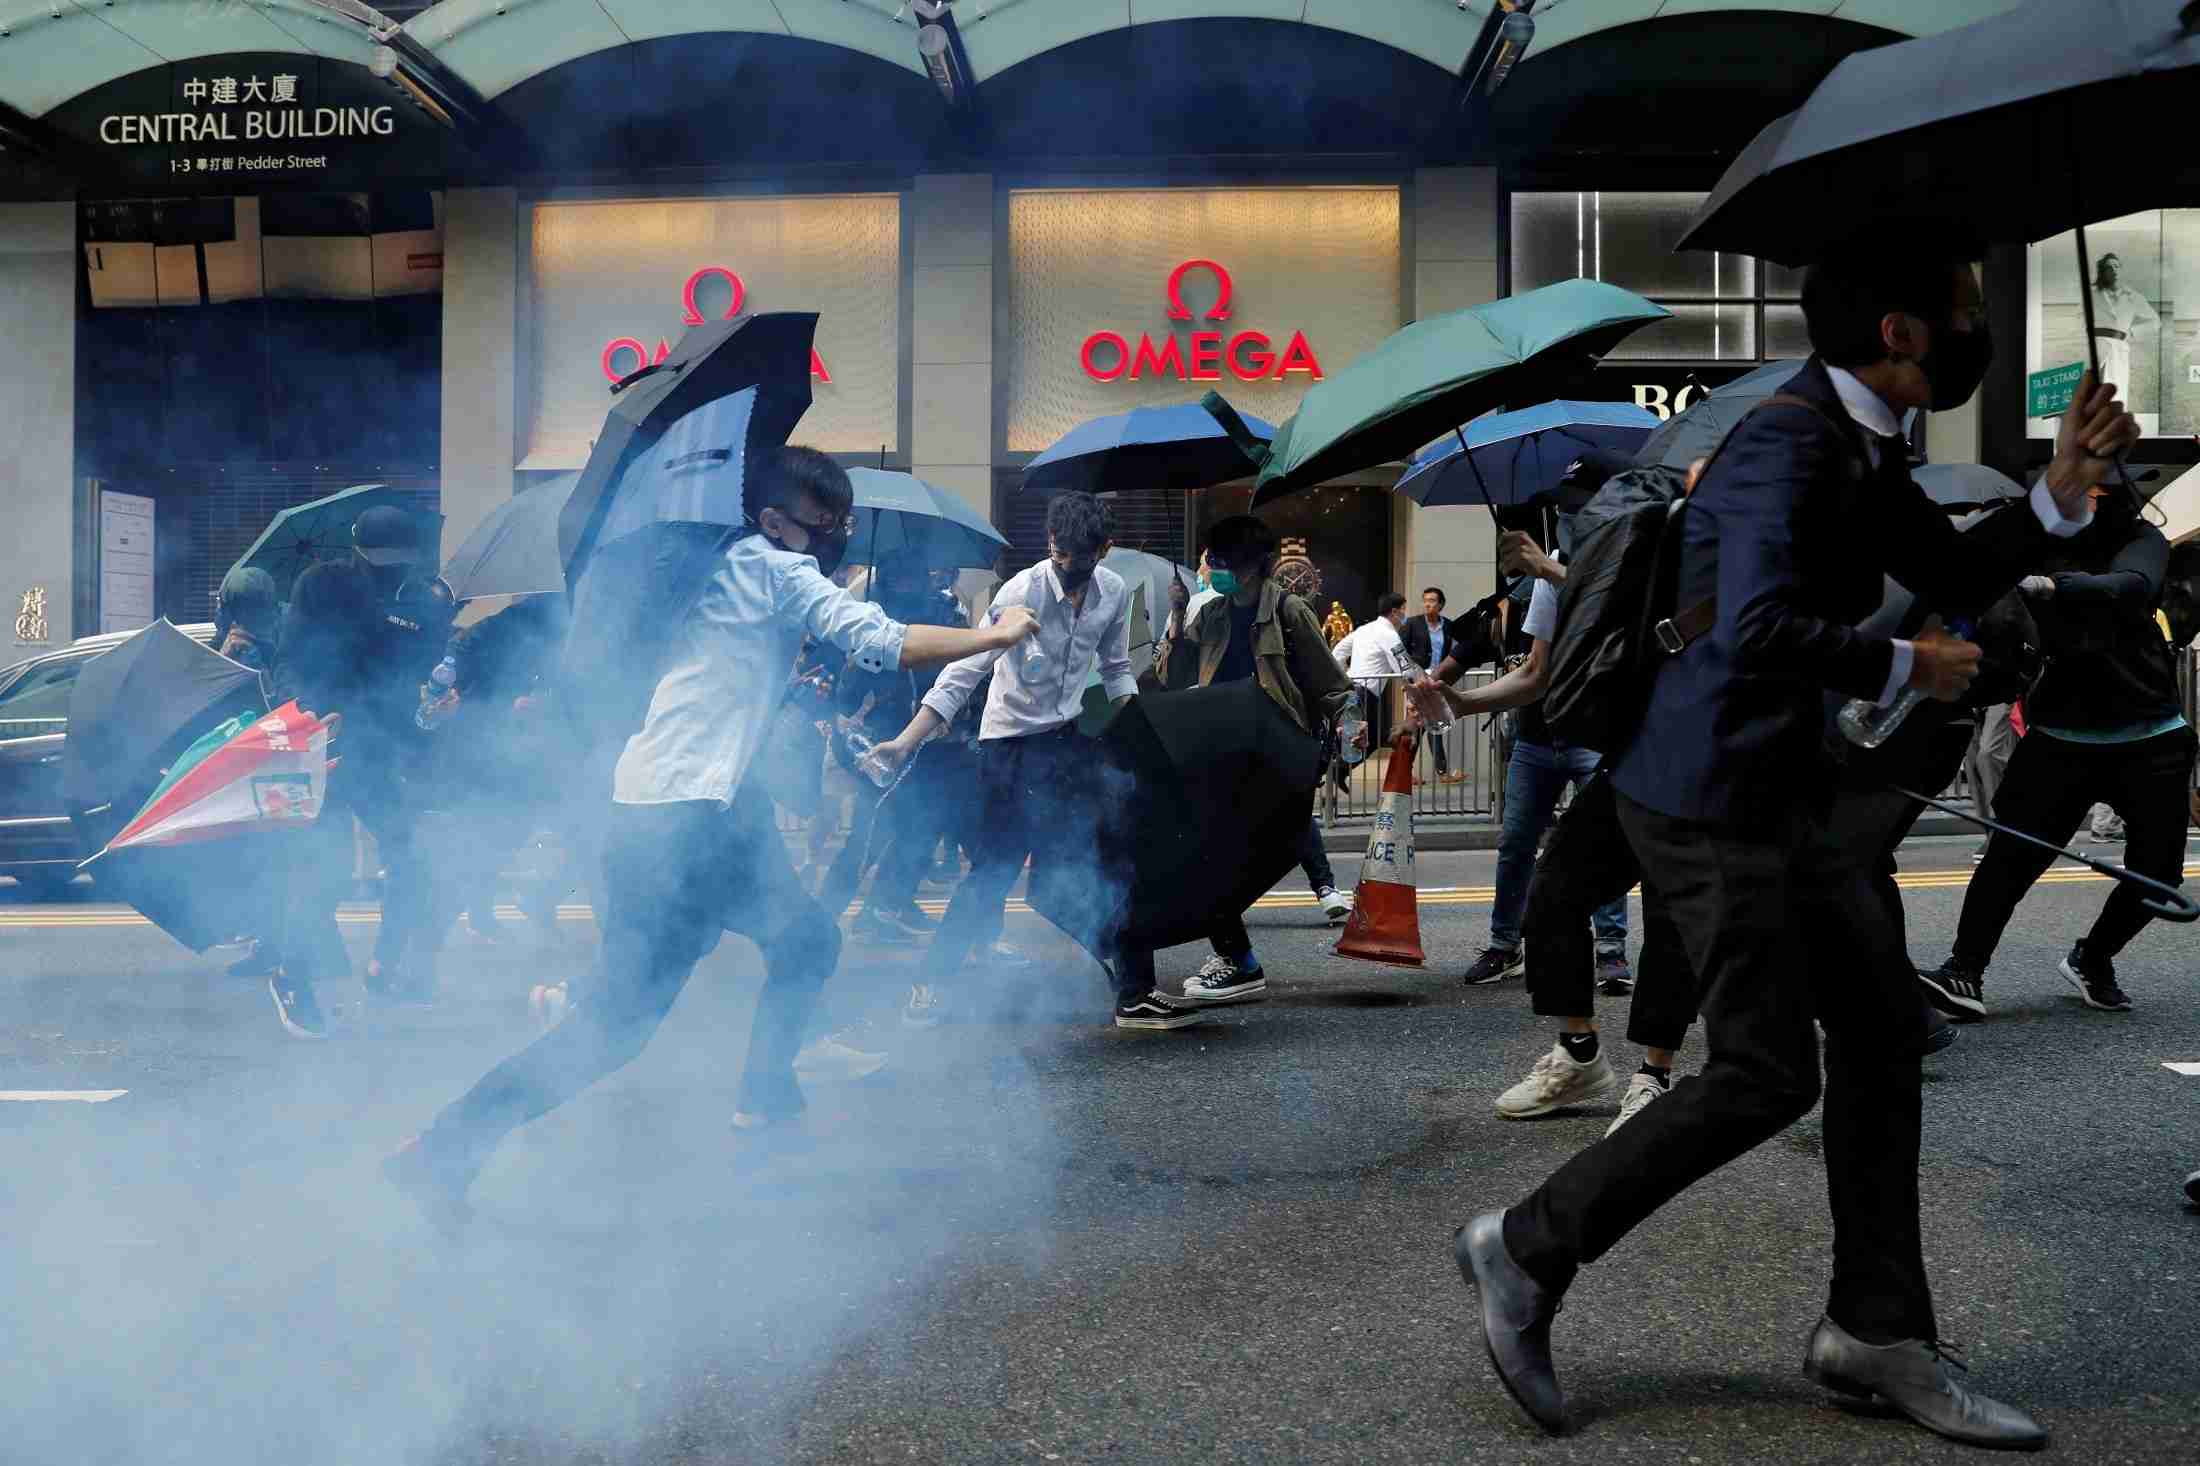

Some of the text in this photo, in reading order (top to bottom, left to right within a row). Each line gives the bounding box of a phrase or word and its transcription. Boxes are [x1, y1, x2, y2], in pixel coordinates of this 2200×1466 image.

[183, 73, 298, 106] 中建大廈
[100, 106, 394, 144] CENTRAL BUILDING
[170, 158, 191, 173] 1-3
[238, 155, 285, 170] Pedder
[287, 154, 327, 168] Street
[1081, 330, 1324, 382] OMEGA
[2052, 369, 2081, 385] STAND
